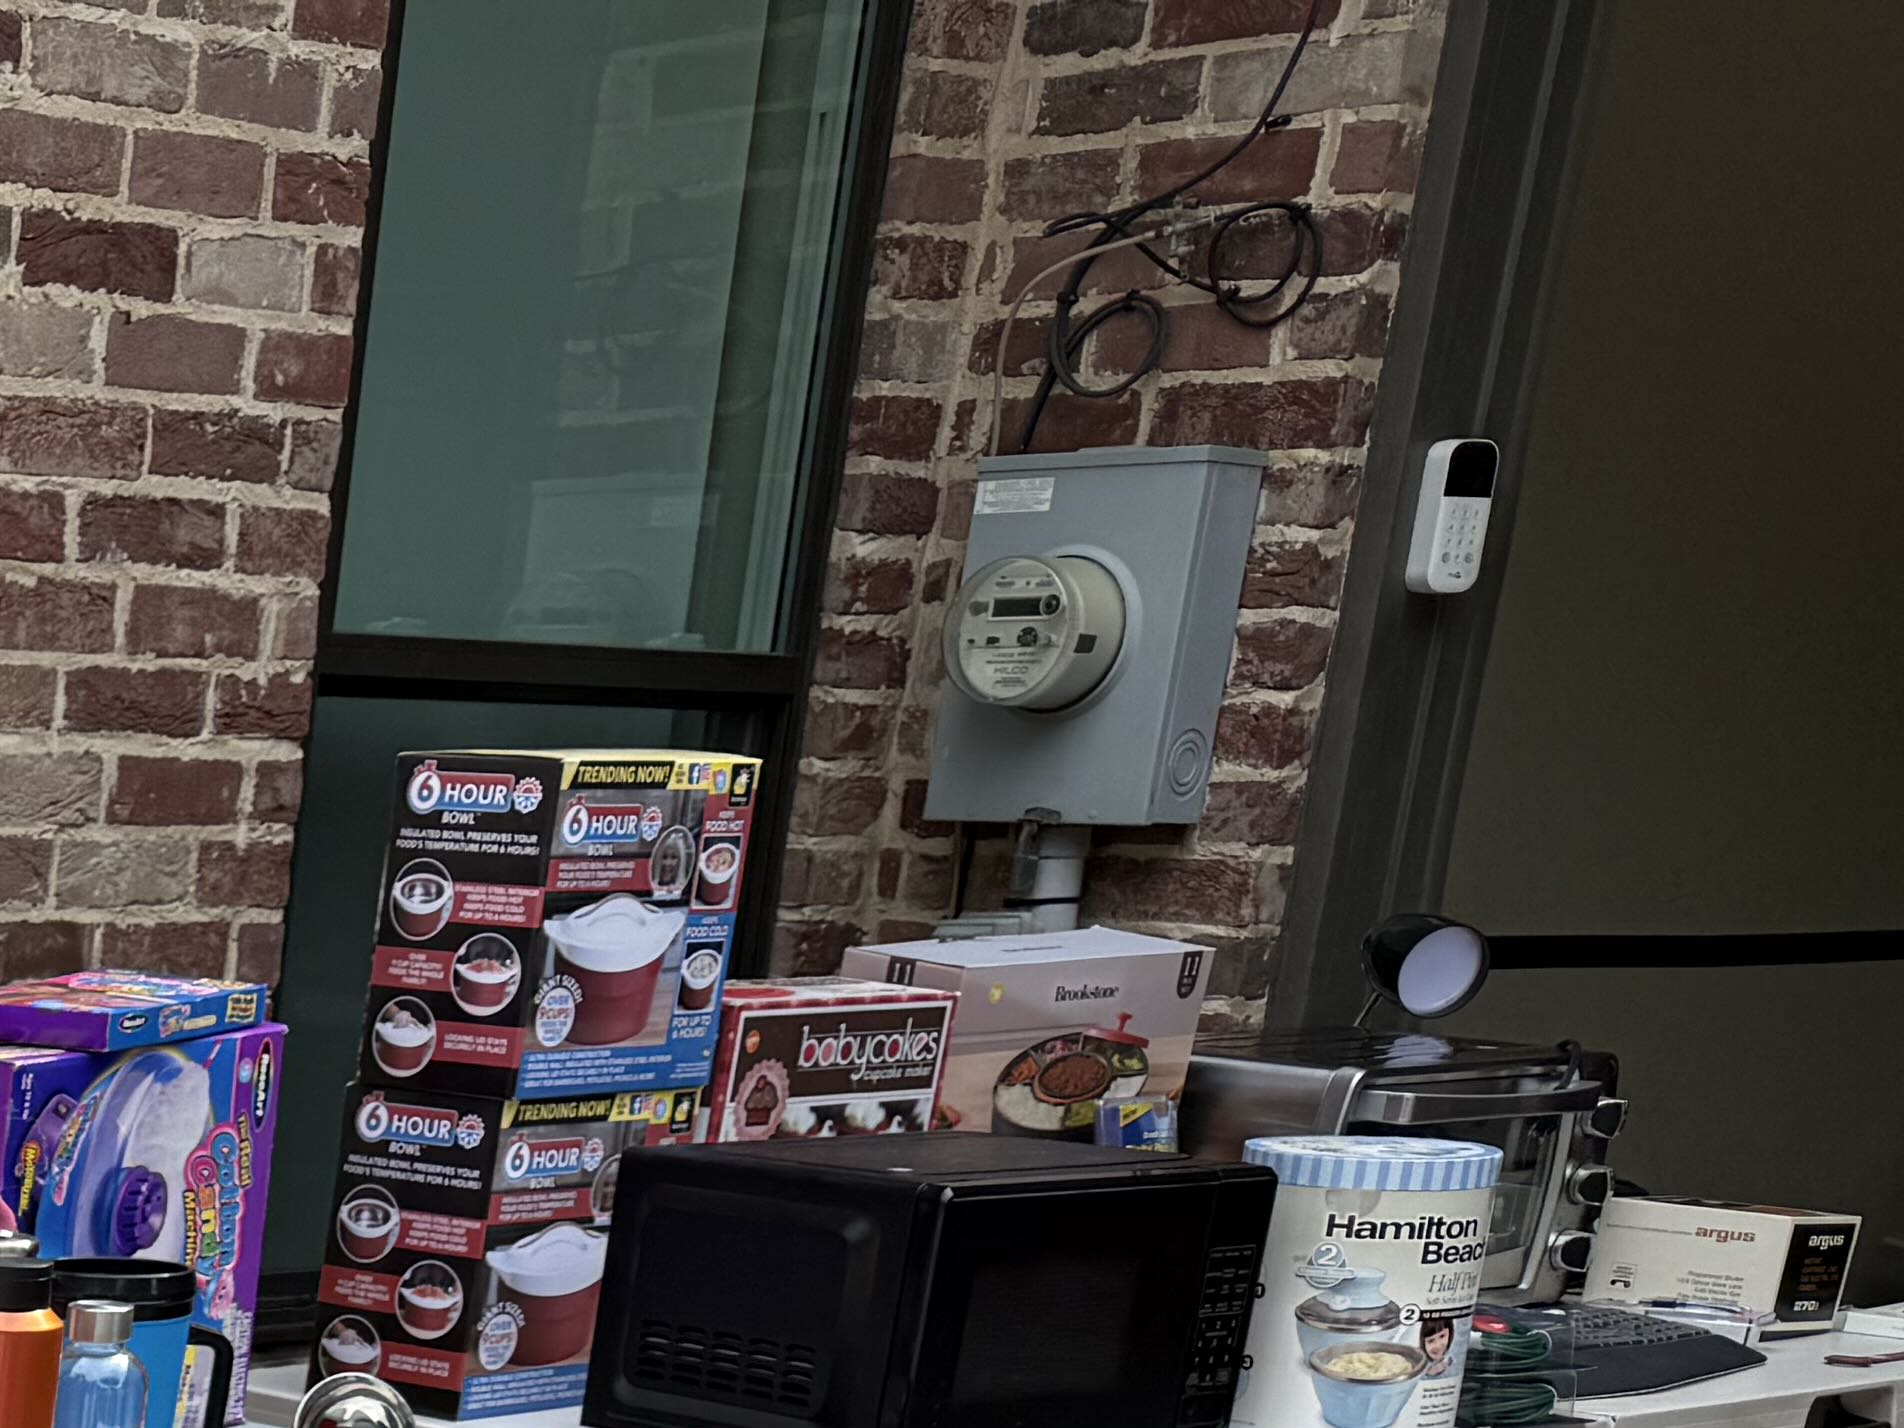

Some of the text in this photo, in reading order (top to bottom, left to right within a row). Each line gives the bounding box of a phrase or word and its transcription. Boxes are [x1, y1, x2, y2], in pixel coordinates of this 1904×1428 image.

[577, 763, 671, 783] TRENDING NOW!
[1054, 984, 1121, 1003] Brookstone
[798, 1017, 939, 1081] babycakes
[863, 1064, 933, 1085] cupcake maker
[1325, 1213, 1479, 1240] Hamilton
[1694, 1225, 1756, 1243] argus
[1808, 1234, 1845, 1251] argus
[1317, 1245, 1338, 1267] 2
